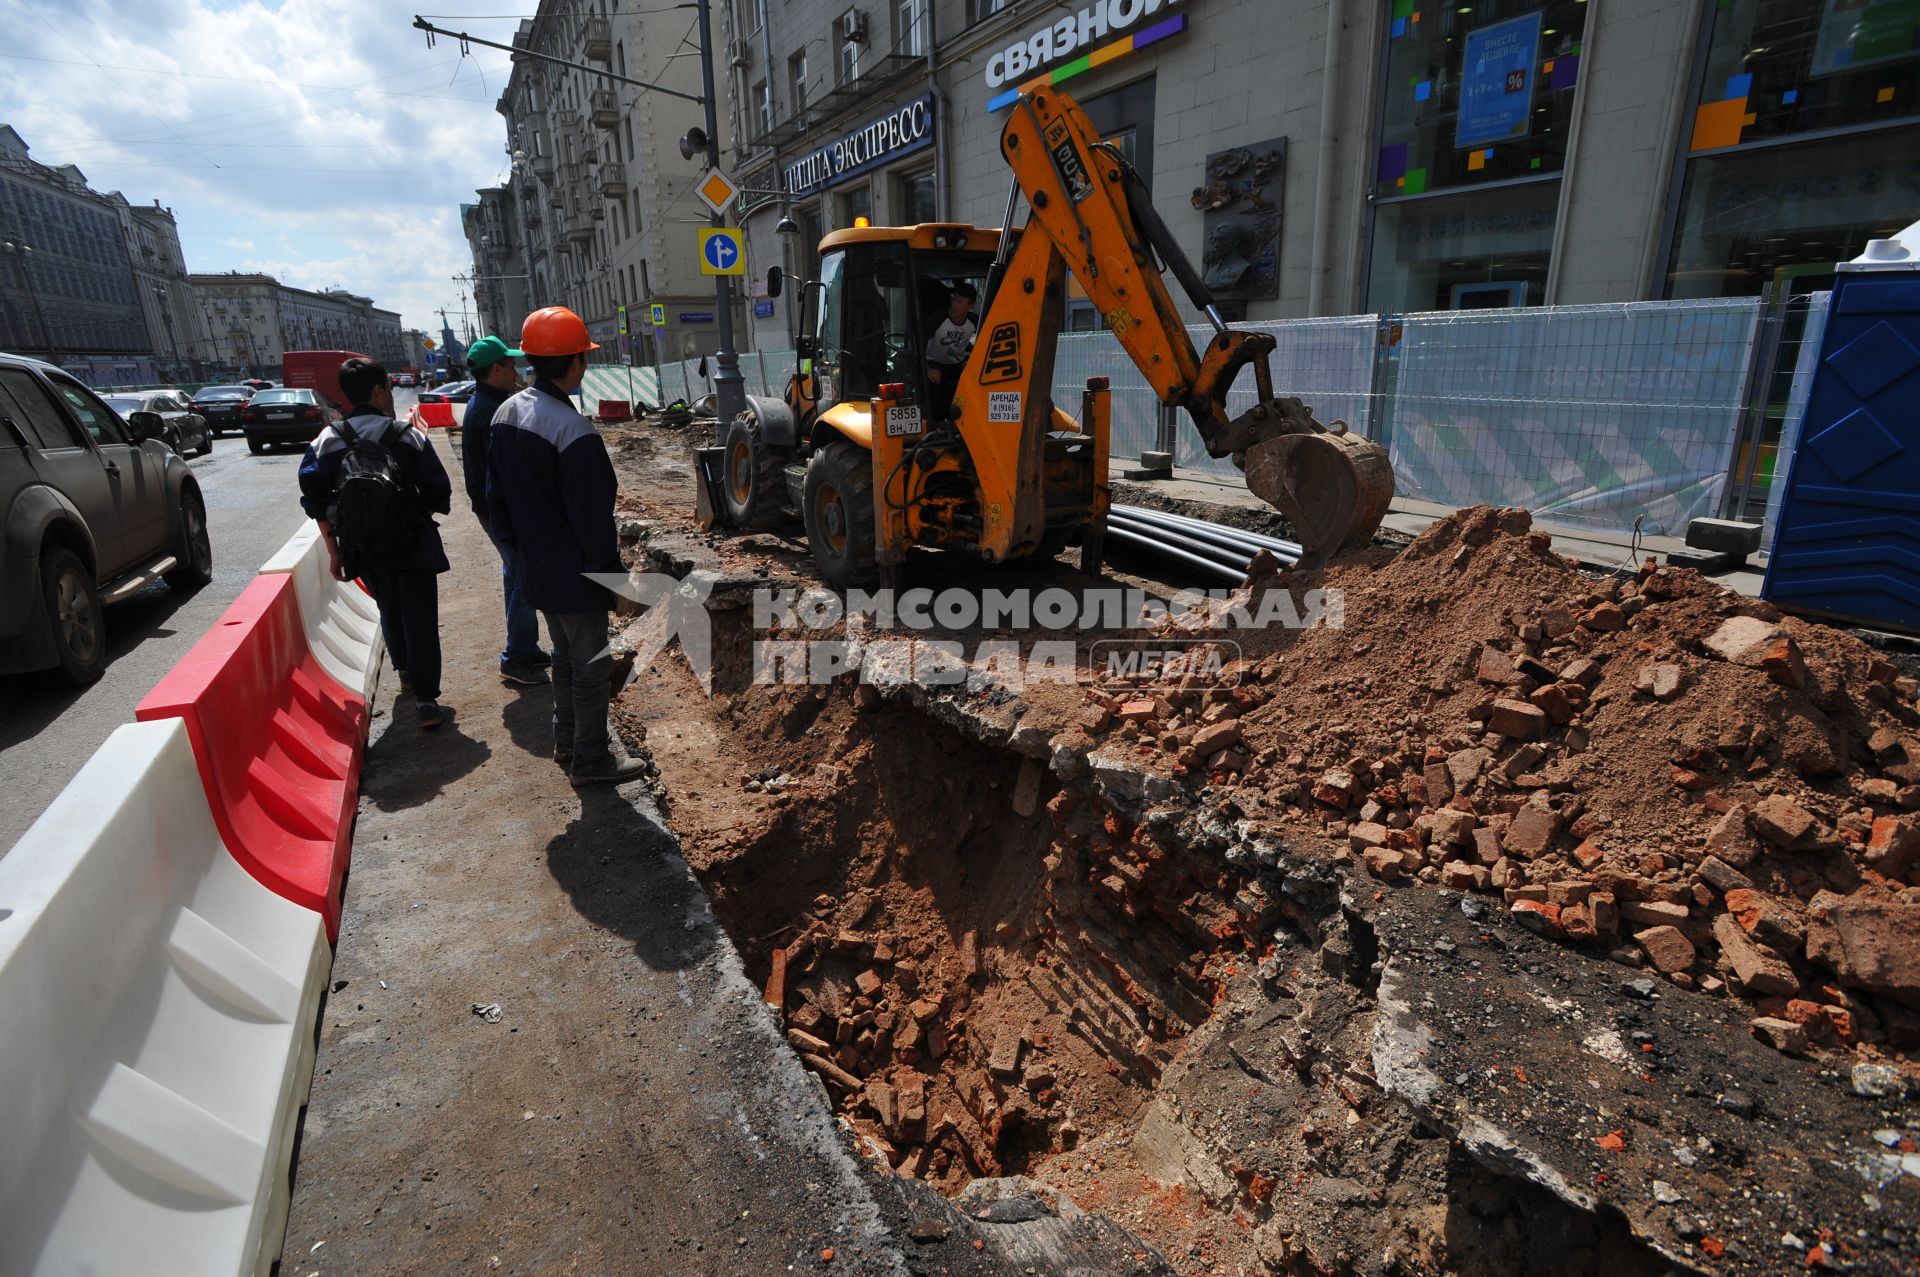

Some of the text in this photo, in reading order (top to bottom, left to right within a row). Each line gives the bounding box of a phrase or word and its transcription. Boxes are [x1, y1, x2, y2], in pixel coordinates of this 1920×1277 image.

[1484, 32, 1518, 49] ВМЕСТЕ
[1479, 44, 1521, 62] ДЕШЕВЛЕ
[834, 100, 925, 173] ЭКСПРЕСС
[985, 326, 1018, 376] JCB
[990, 394, 1020, 403] АРЕНДА
[890, 408, 917, 420] 5858
[993, 404, 1016, 413] 8 (916)-
[990, 412, 1019, 420] 929 73 69
[890, 422, 919, 434] ВН 77
